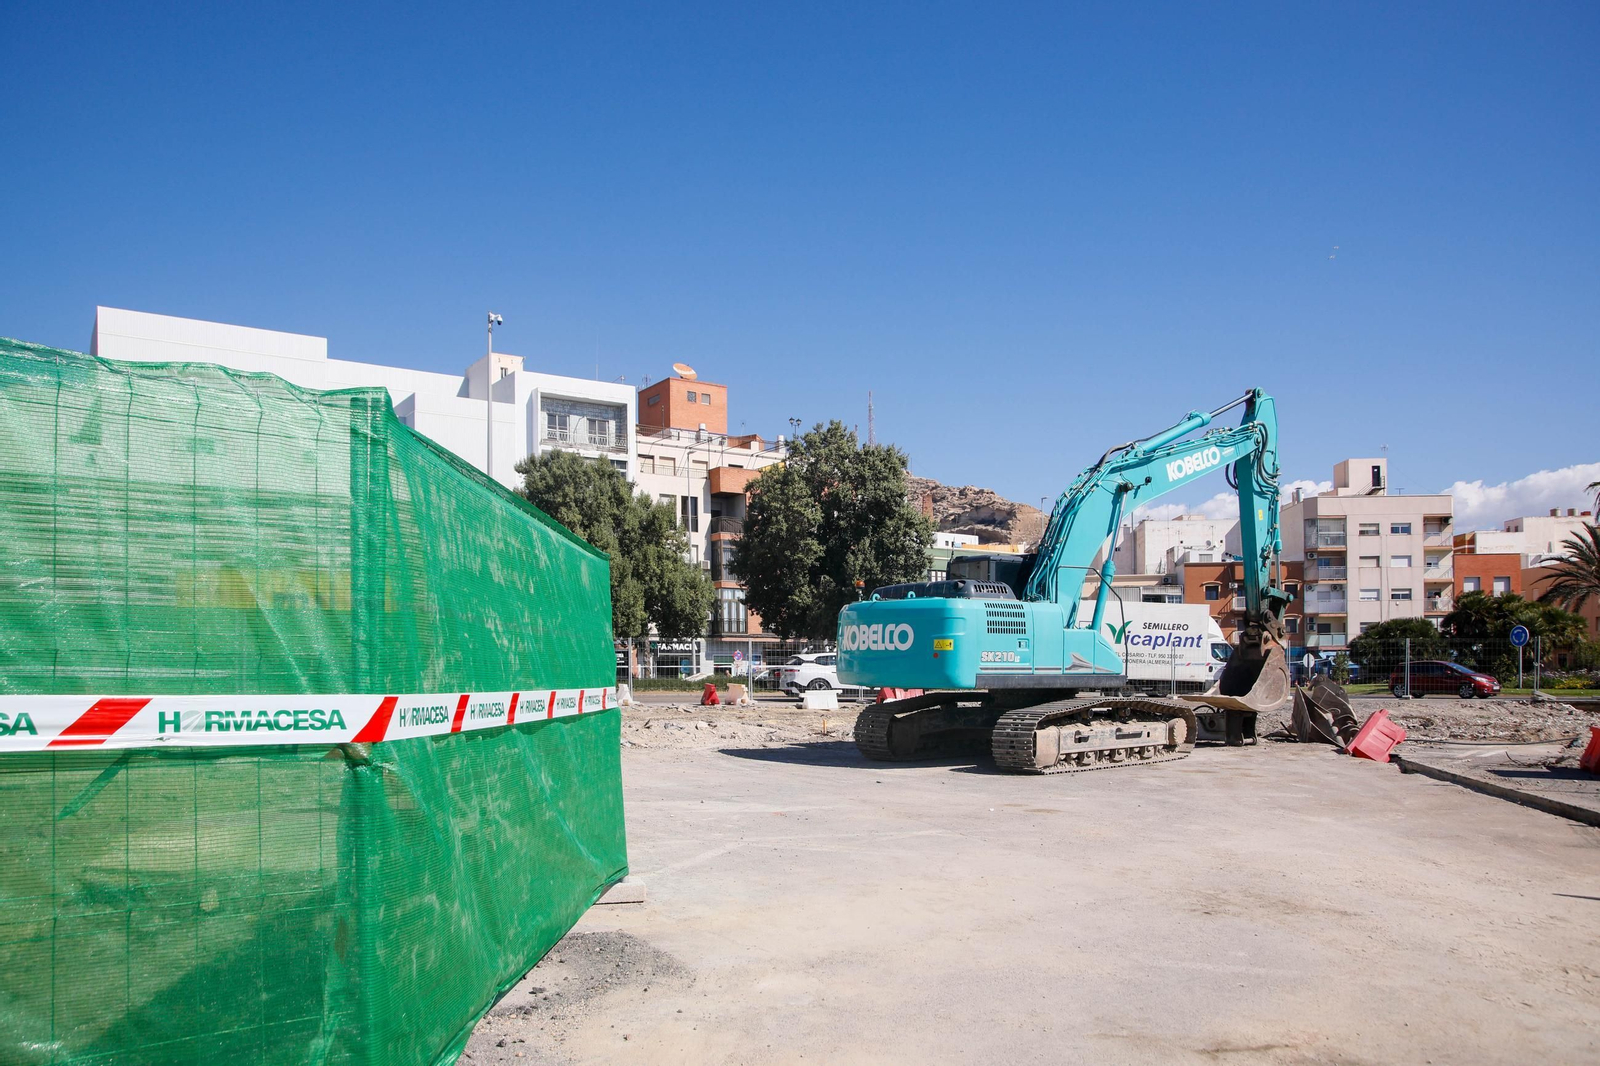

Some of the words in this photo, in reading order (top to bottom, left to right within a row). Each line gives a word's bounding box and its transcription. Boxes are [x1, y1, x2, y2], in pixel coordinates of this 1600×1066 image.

[1166, 446, 1221, 482] KOBELCO
[843, 623, 915, 651] KOBELCO
[1142, 622, 1189, 631] SEMILLERO
[158, 709, 347, 733] HORMACESA
[399, 705, 449, 728] HORMACESA
[470, 702, 505, 720] HORMACESA
